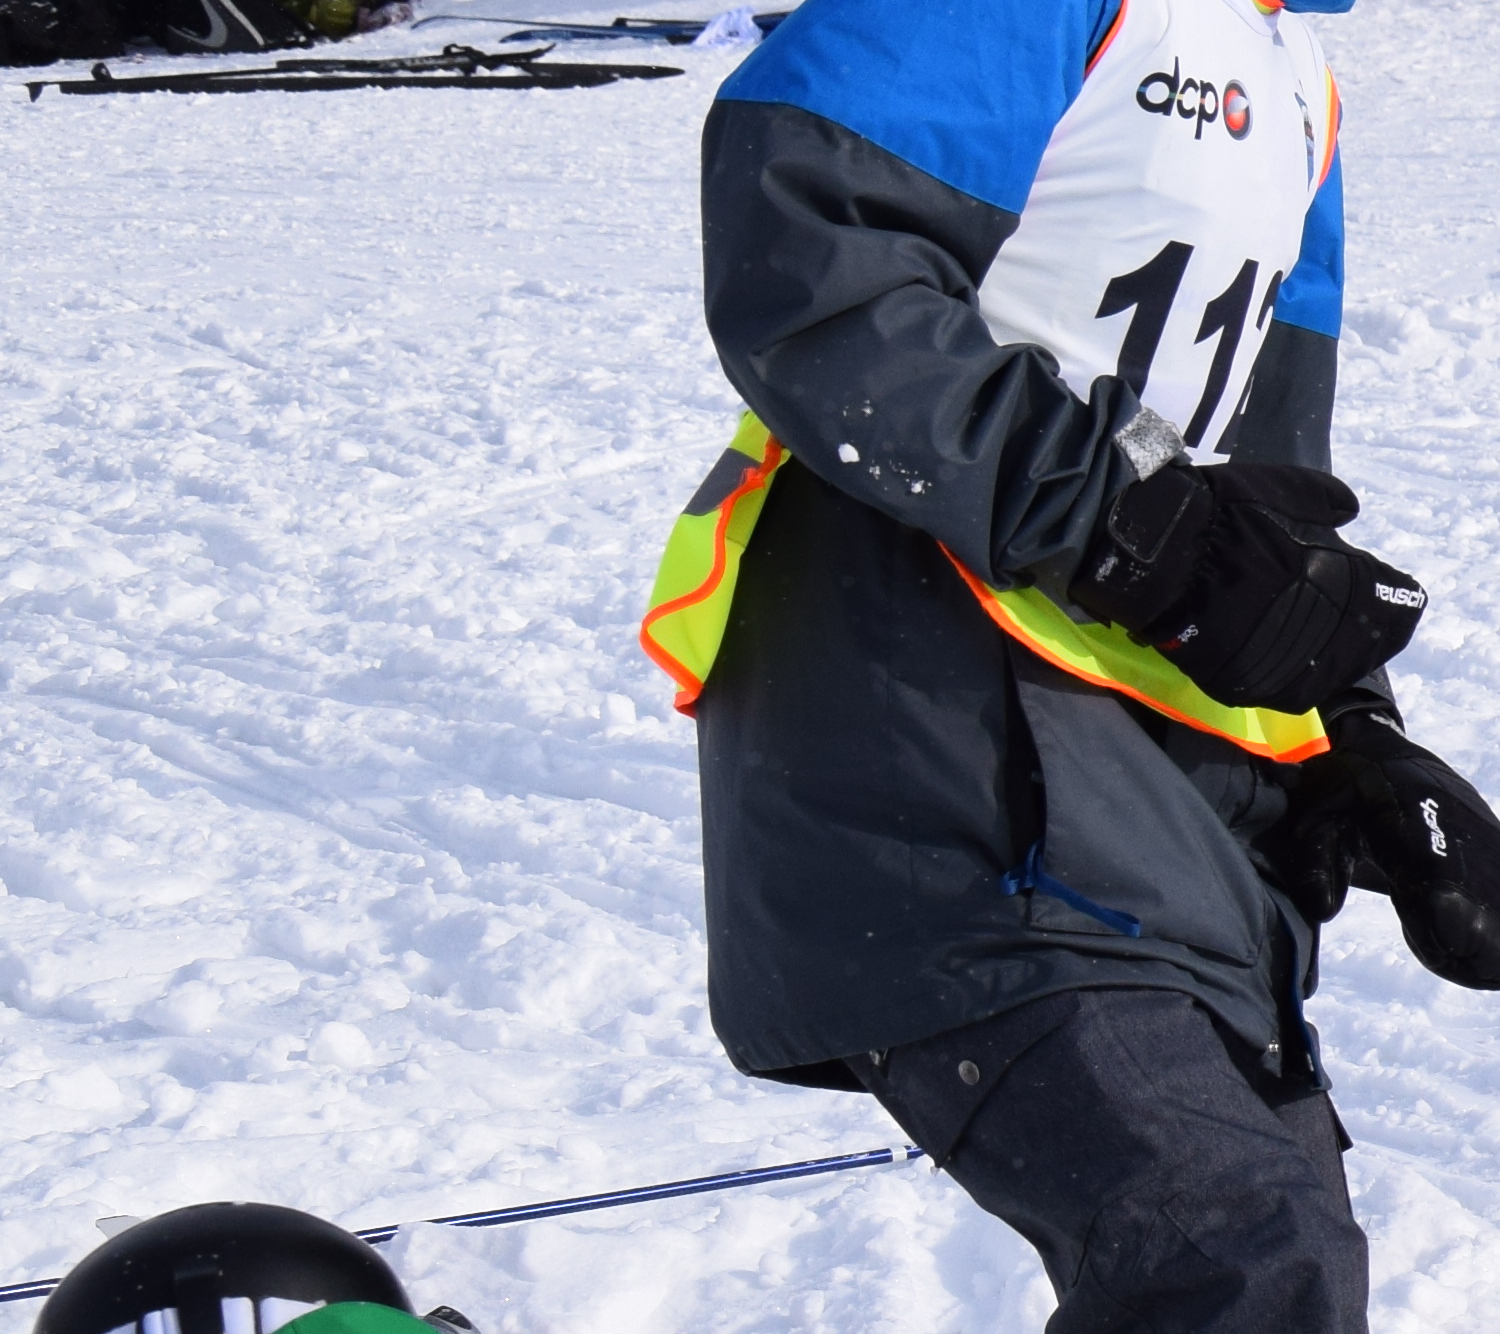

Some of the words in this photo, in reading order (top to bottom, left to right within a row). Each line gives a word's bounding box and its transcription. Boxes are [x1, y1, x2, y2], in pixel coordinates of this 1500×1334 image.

[1136, 55, 1220, 140] dcp
[1375, 582, 1426, 610] reusch
[1420, 798, 1448, 857] reusch
